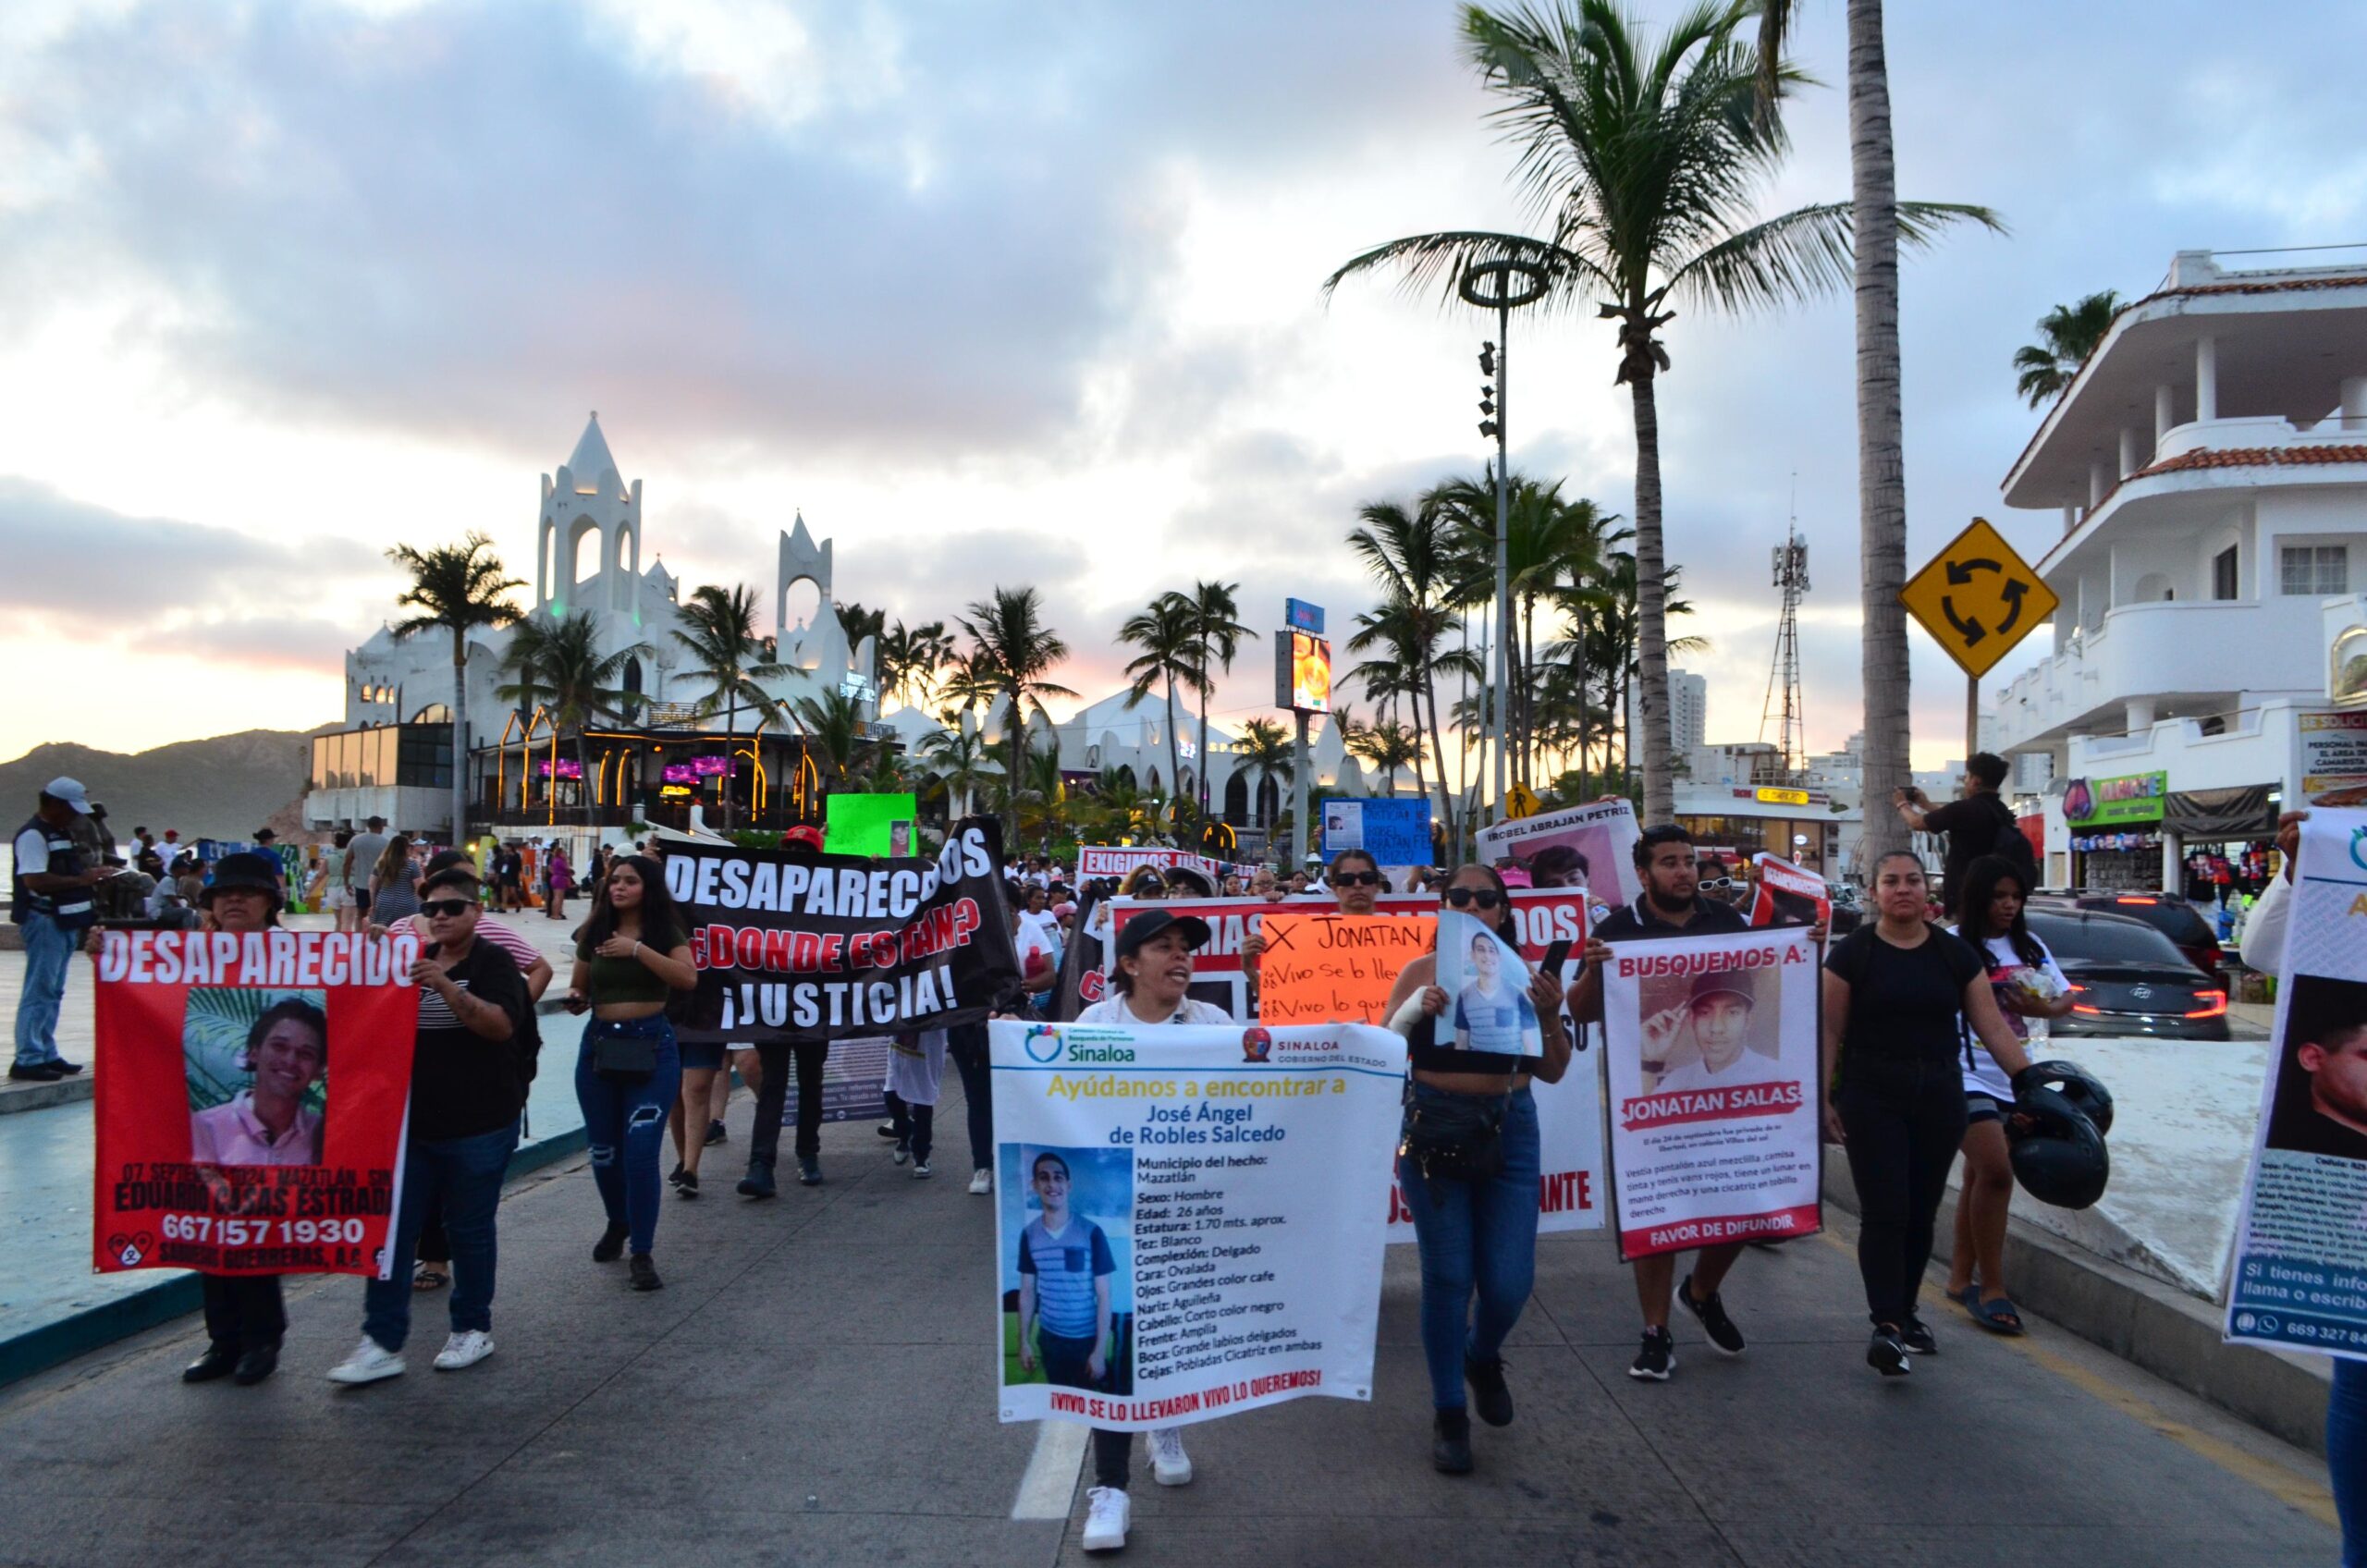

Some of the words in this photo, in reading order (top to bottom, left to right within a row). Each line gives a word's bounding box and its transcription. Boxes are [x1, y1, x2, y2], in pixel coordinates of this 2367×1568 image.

[1488, 827, 1527, 842] IROBEL
[1530, 815, 1584, 833] ABRAJAN
[1588, 806, 1630, 822] PETRIZ
[1086, 852, 1171, 873] EXIGIMOS
[690, 924, 844, 974] ¿DONDE
[849, 897, 981, 970] ESTÁN?
[1264, 921, 1298, 953] X
[1311, 917, 1421, 949] JONATAN
[100, 930, 418, 988] DESAPARECIDO
[1619, 947, 1775, 978] BUSQUEMOS
[1783, 945, 1808, 964] A:
[720, 964, 957, 1029] ¡JUSTICIA!
[1068, 1044, 1135, 1062] Sinaloa
[1278, 1041, 1339, 1050] SINALOA
[1349, 1056, 1387, 1067] ESTADO
[1047, 1074, 1177, 1101] Ayúdanos
[1184, 1081, 1198, 1097] a
[1206, 1078, 1326, 1097] encontrar
[1331, 1078, 1346, 1094] a
[1147, 1105, 1191, 1123] José
[1196, 1101, 1252, 1125] Ángel
[1623, 1093, 1724, 1122] JONATAN
[1730, 1085, 1800, 1109] SALAS
[1110, 1127, 1134, 1144] de
[1140, 1126, 1207, 1145] Robles
[1212, 1125, 1285, 1143] Salcedo
[1137, 1158, 1202, 1171] Municipio
[1205, 1156, 1224, 1168] del
[1228, 1155, 1268, 1167] hecho:
[1697, 1158, 1717, 1169] azul
[1137, 1171, 1196, 1184] Mazatlán
[115, 1182, 209, 1212] EDUARDO
[214, 1186, 288, 1217] CASAS
[1137, 1192, 1171, 1204] Sexo:
[1173, 1189, 1224, 1201] Hombre
[1135, 1207, 1171, 1220] Edad:
[1176, 1207, 1193, 1218] 26
[1195, 1205, 1224, 1217] años
[163, 1214, 212, 1243] 667
[216, 1219, 270, 1245] 157
[278, 1219, 365, 1243] 1930
[1134, 1222, 1191, 1235] Estatura:
[1195, 1219, 1221, 1231] 1.70
[1222, 1218, 1247, 1228] mts.
[1250, 1215, 1286, 1228] aprox.
[1650, 1224, 1699, 1247] FAVOR
[1702, 1222, 1723, 1237] DE
[1726, 1214, 1795, 1236] DIFUNDIR
[1134, 1238, 1158, 1250] Tez:
[1161, 1235, 1202, 1247] Blanco
[1134, 1248, 1209, 1266] Complexión:
[1212, 1243, 1261, 1258] Delgado
[1135, 1269, 1166, 1282] Cara:
[1168, 1262, 1216, 1277] Ovalada
[2245, 1262, 2263, 1277] Si
[2270, 1266, 2324, 1285] tienes
[1135, 1286, 1166, 1300] Ojos:
[1168, 1277, 1216, 1293] Grandes
[1218, 1274, 1247, 1286] color
[2242, 1280, 2288, 1299] llama
[2294, 1290, 2306, 1301] o
[1137, 1302, 1171, 1316] Nariz:
[1172, 1292, 1221, 1311] Aguileña
[1137, 1315, 1183, 1332] Cabello:
[1184, 1310, 1217, 1323] Corto
[1219, 1305, 1248, 1317] color
[1250, 1302, 1284, 1315] negro
[1138, 1333, 1178, 1349] Frente:
[1180, 1323, 1218, 1339] Amplia
[2287, 1322, 2316, 1337] 669
[2319, 1326, 2348, 1341] 327
[1138, 1351, 1171, 1365] Boca:
[1171, 1341, 1210, 1357] Grande
[1213, 1333, 1245, 1348] labios
[1247, 1328, 1297, 1342] delgados
[1138, 1366, 1174, 1381] Cejas:
[1176, 1354, 1222, 1373] Pobladas
[1224, 1344, 1267, 1362] Cicatriz
[1269, 1344, 1283, 1354] en
[1285, 1340, 1322, 1353] ambas
[1050, 1392, 1085, 1415] ¡VIVO
[1089, 1398, 1105, 1419] SE
[1110, 1403, 1126, 1422] LO
[1132, 1392, 1199, 1421] LLEVARON
[1203, 1385, 1229, 1407] VIVO
[1233, 1381, 1247, 1401] LO
[1252, 1368, 1321, 1398] QUEREMOS!
